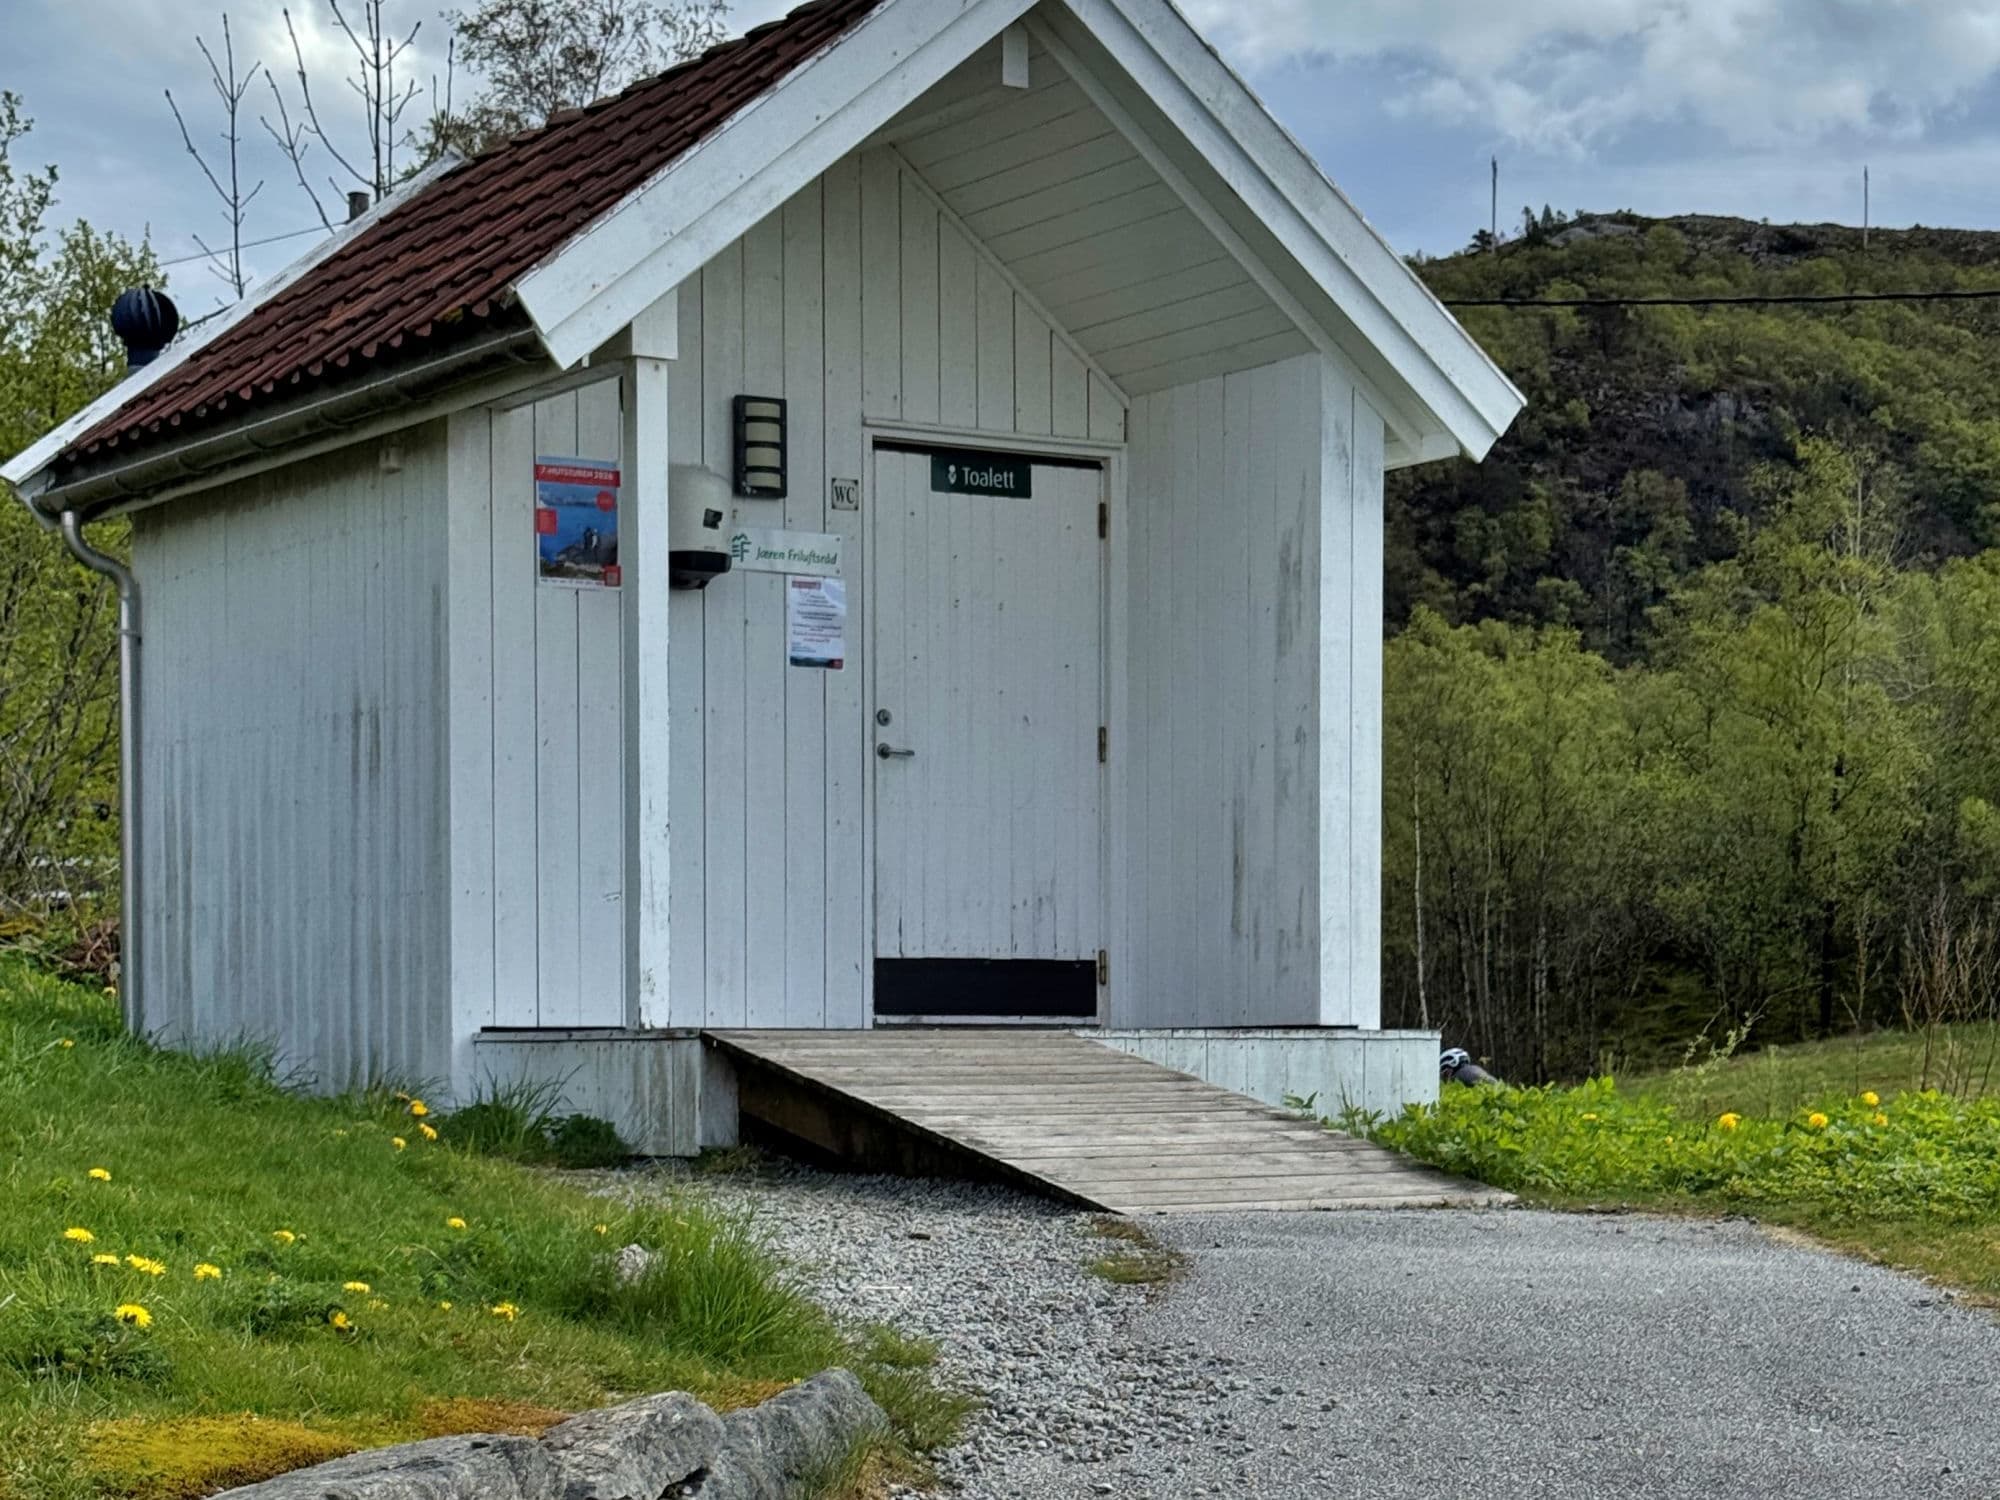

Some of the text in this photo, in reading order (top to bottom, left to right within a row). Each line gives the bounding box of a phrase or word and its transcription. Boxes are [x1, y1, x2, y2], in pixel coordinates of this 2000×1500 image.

[962, 467, 1015, 489] Toalett
[834, 486, 856, 504] WC
[756, 547, 785, 560] Jæren
